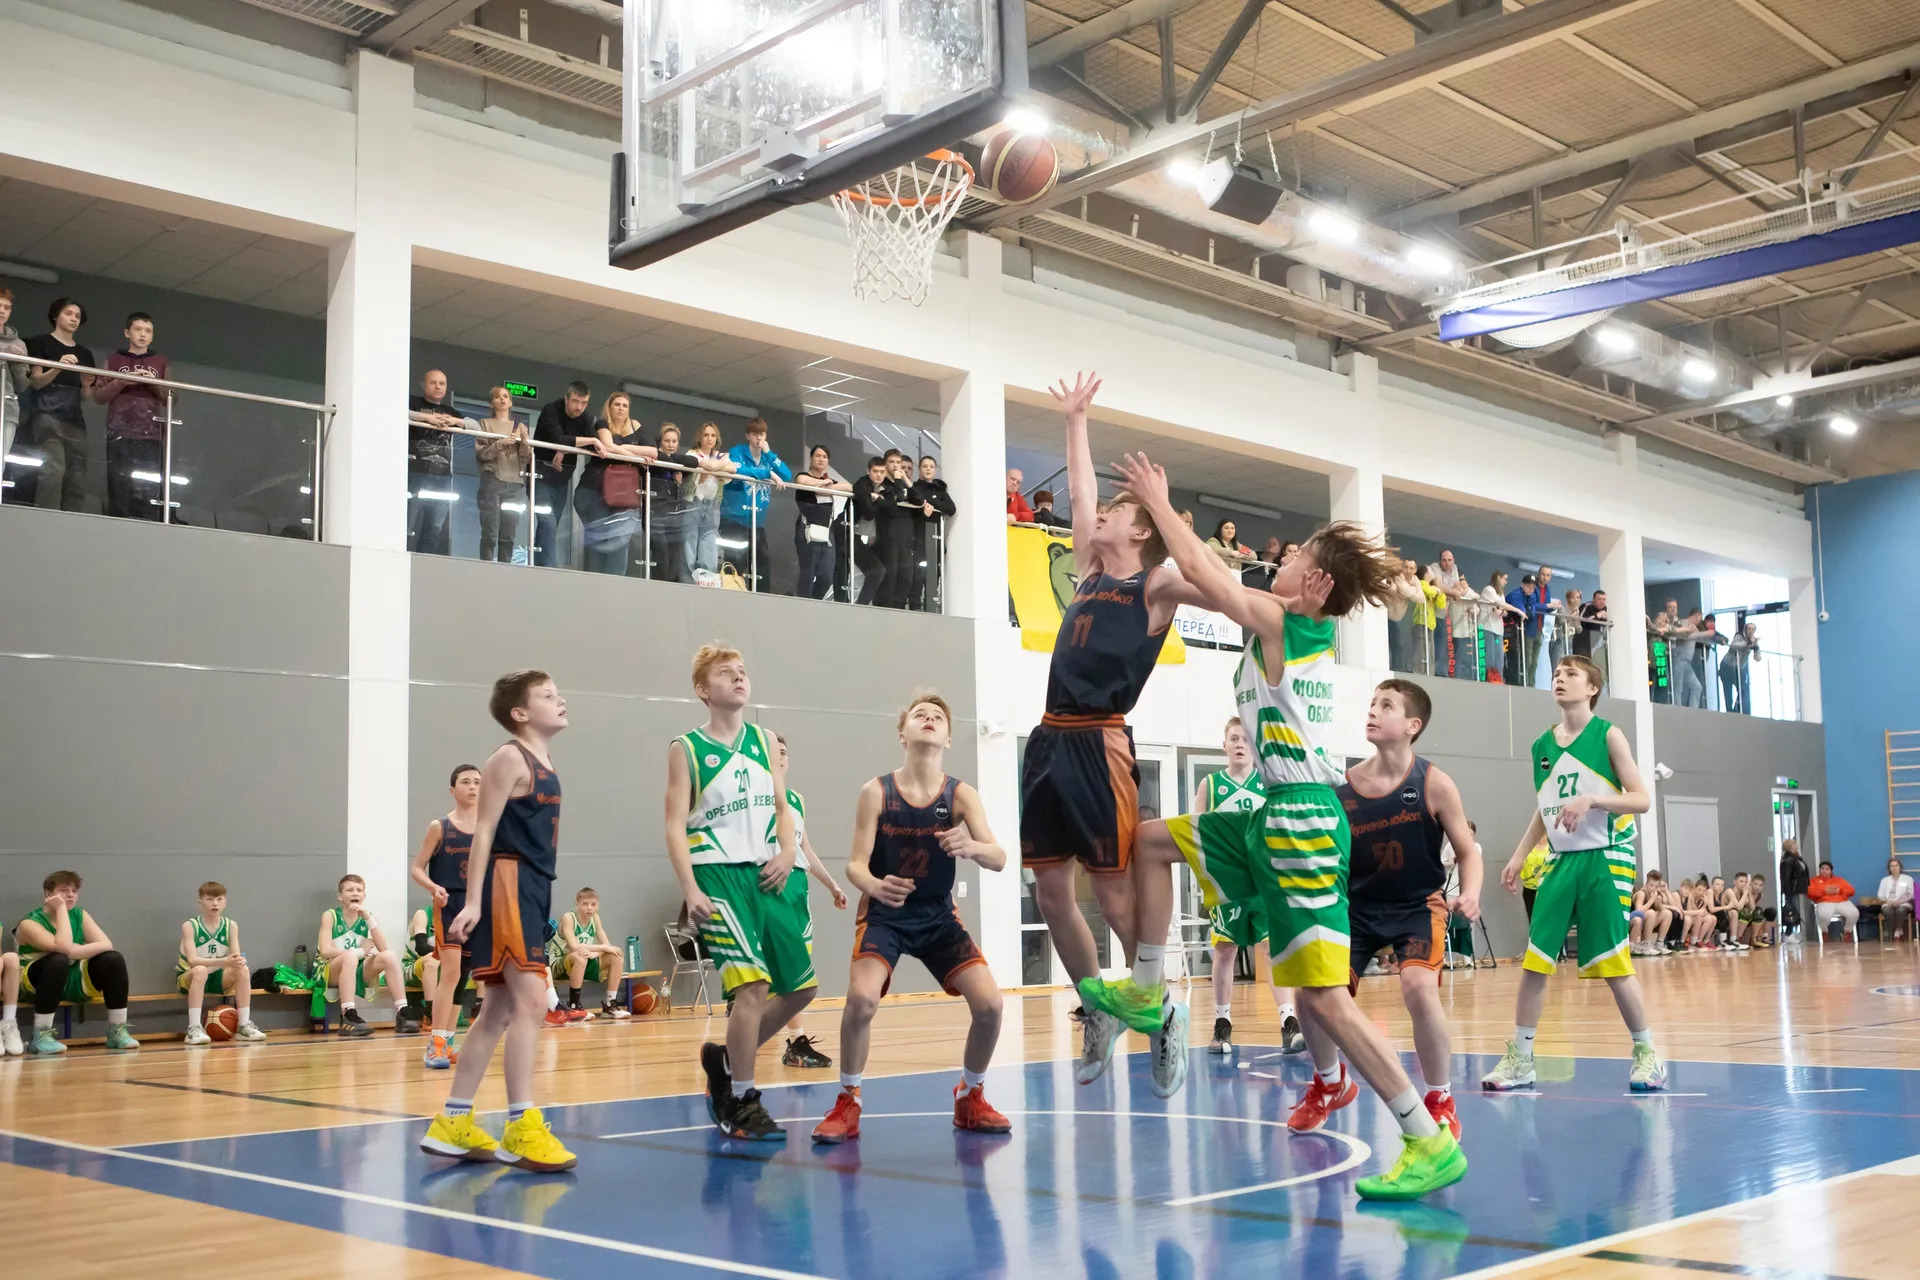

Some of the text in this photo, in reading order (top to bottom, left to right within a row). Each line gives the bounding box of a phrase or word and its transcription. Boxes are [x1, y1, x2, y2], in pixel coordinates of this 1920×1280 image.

[1071, 614, 1094, 648] 11
[734, 767, 751, 793] 21
[1557, 772, 1579, 799] 27
[1234, 797, 1253, 812] 19
[1543, 804, 1566, 816] ОРЕХ
[899, 847, 929, 877] 22
[207, 944, 217, 954] 16
[344, 938, 357, 950] 34
